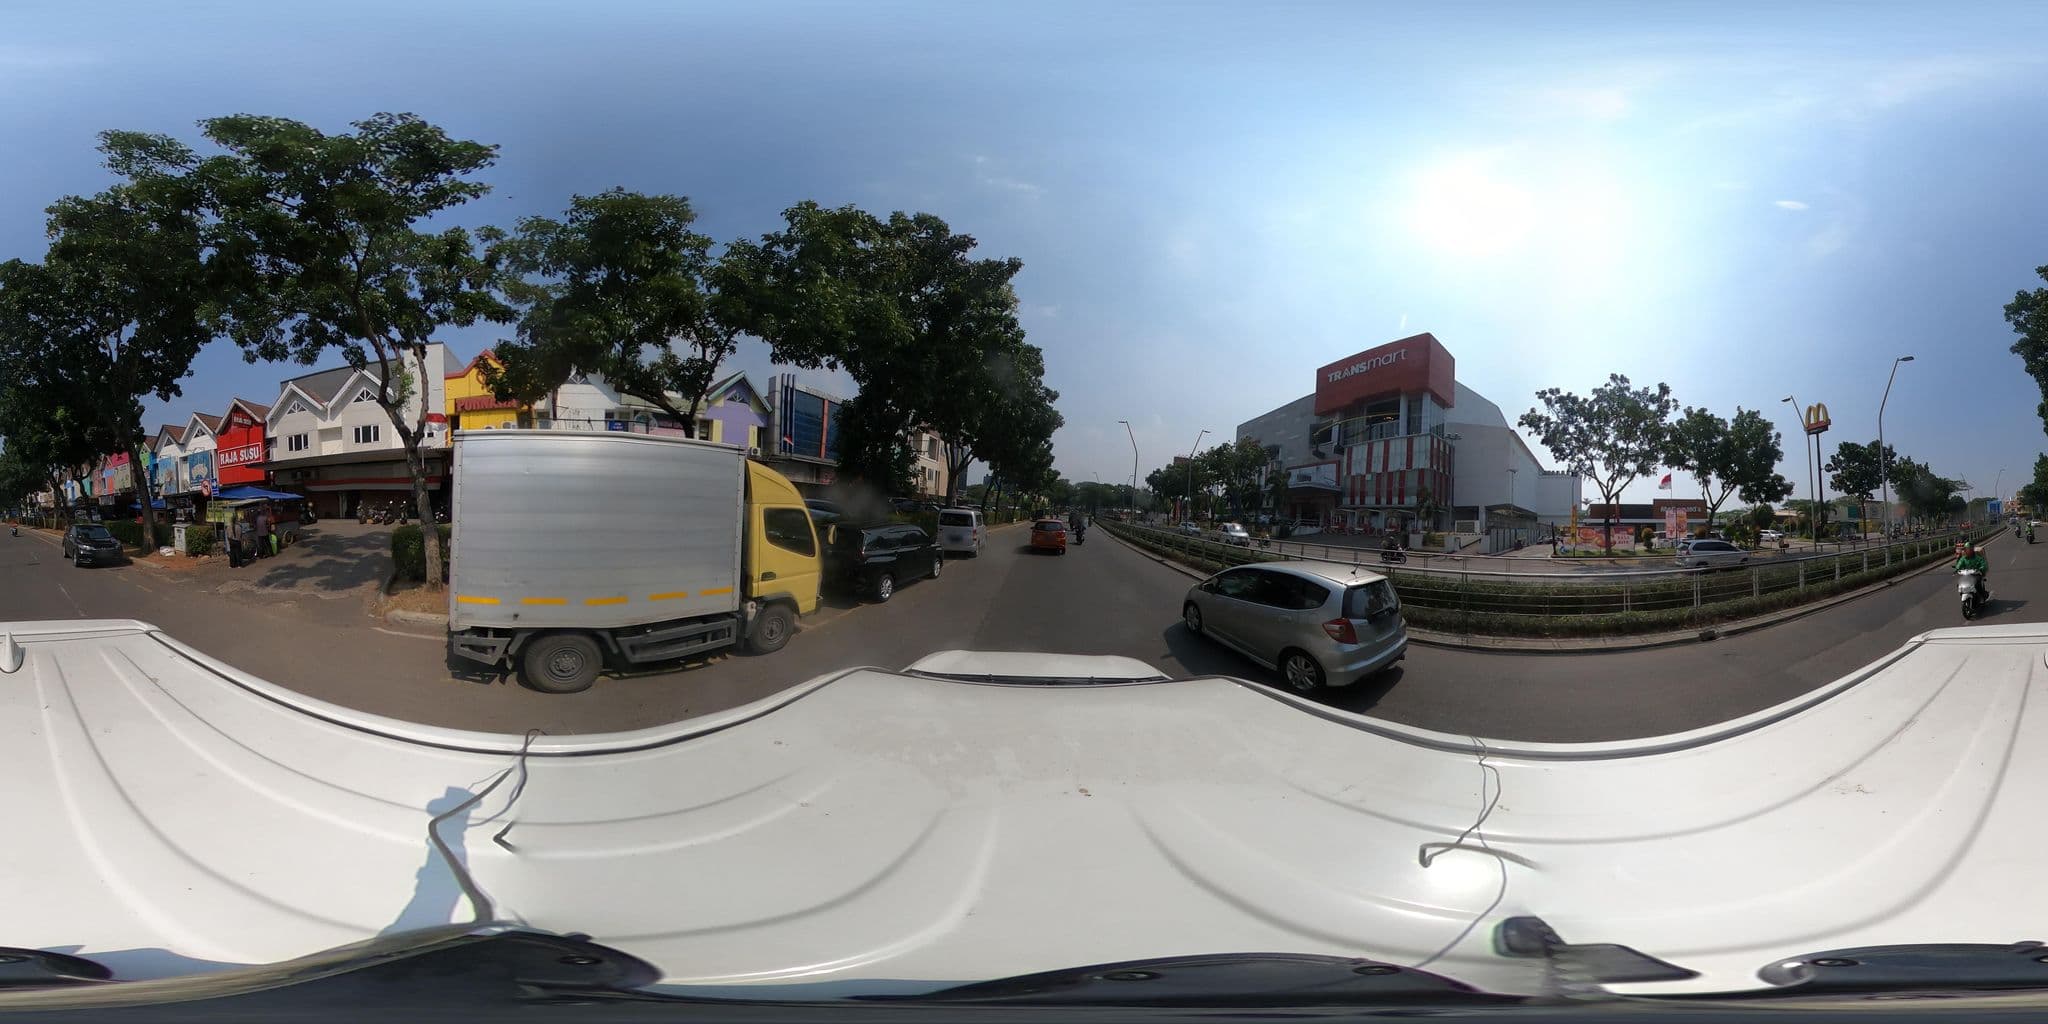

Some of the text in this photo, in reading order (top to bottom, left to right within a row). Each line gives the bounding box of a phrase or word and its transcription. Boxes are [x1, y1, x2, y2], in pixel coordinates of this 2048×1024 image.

[1327, 348, 1408, 383] TRANSmart
[220, 446, 260, 465] RAJA SUSU
